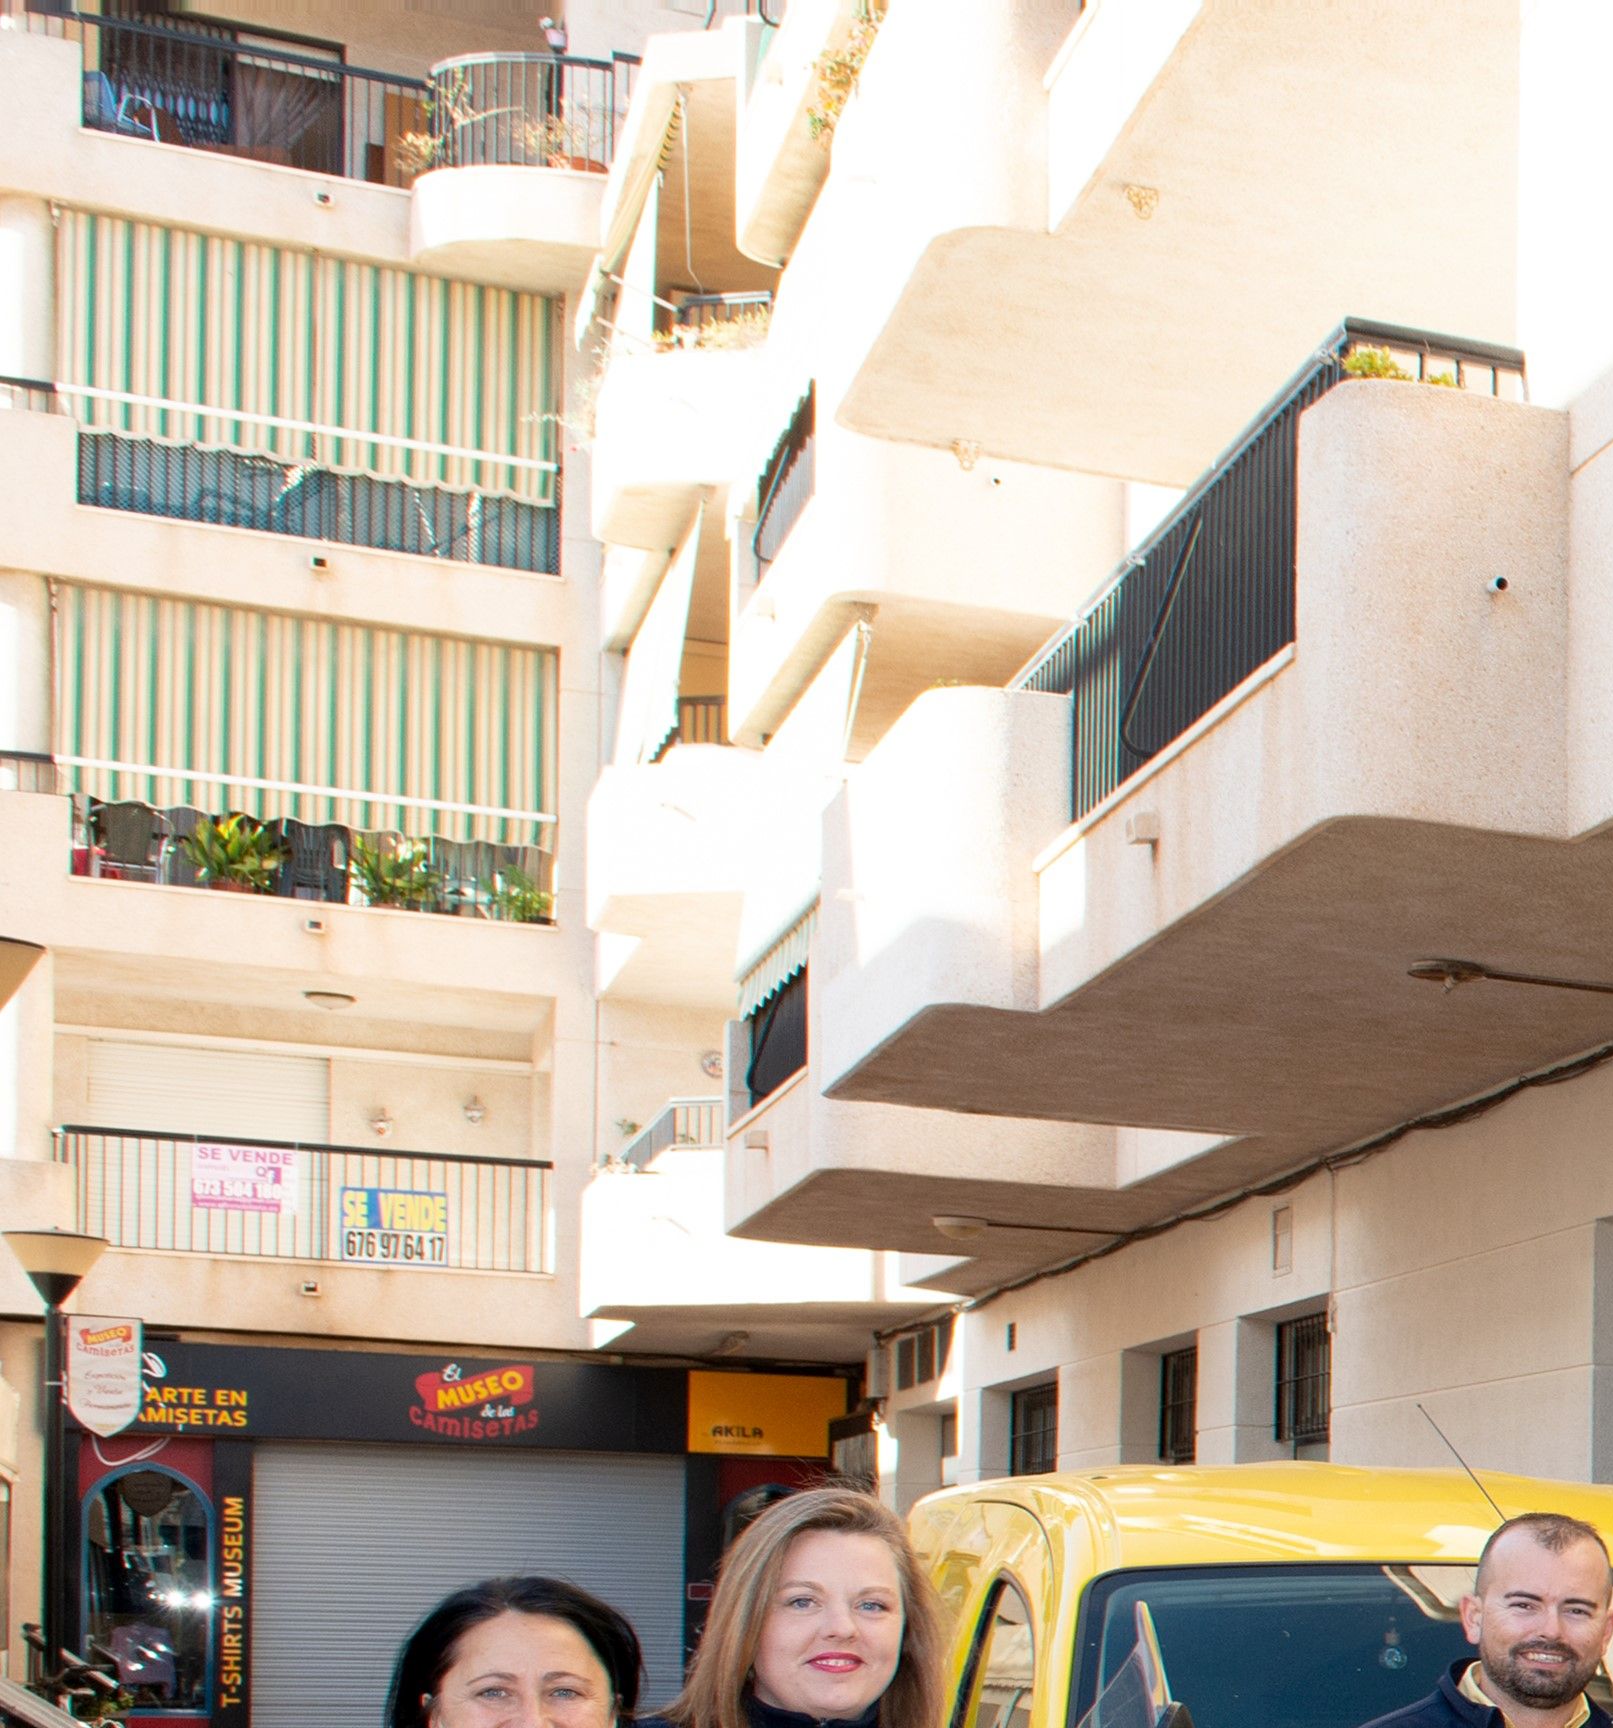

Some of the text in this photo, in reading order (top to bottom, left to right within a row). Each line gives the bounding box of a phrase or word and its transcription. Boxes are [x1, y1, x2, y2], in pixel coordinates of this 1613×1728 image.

[198, 1146, 294, 1166] SE VENDE
[343, 1190, 448, 1233] SE VENDE
[346, 1230, 446, 1262] 676 97 64 17
[85, 1326, 127, 1345] MUSEO
[145, 1387, 248, 1407] ARTE EN
[436, 1370, 524, 1410] MUSEO
[221, 1496, 244, 1708] T-SHIRTS MUSEUM
